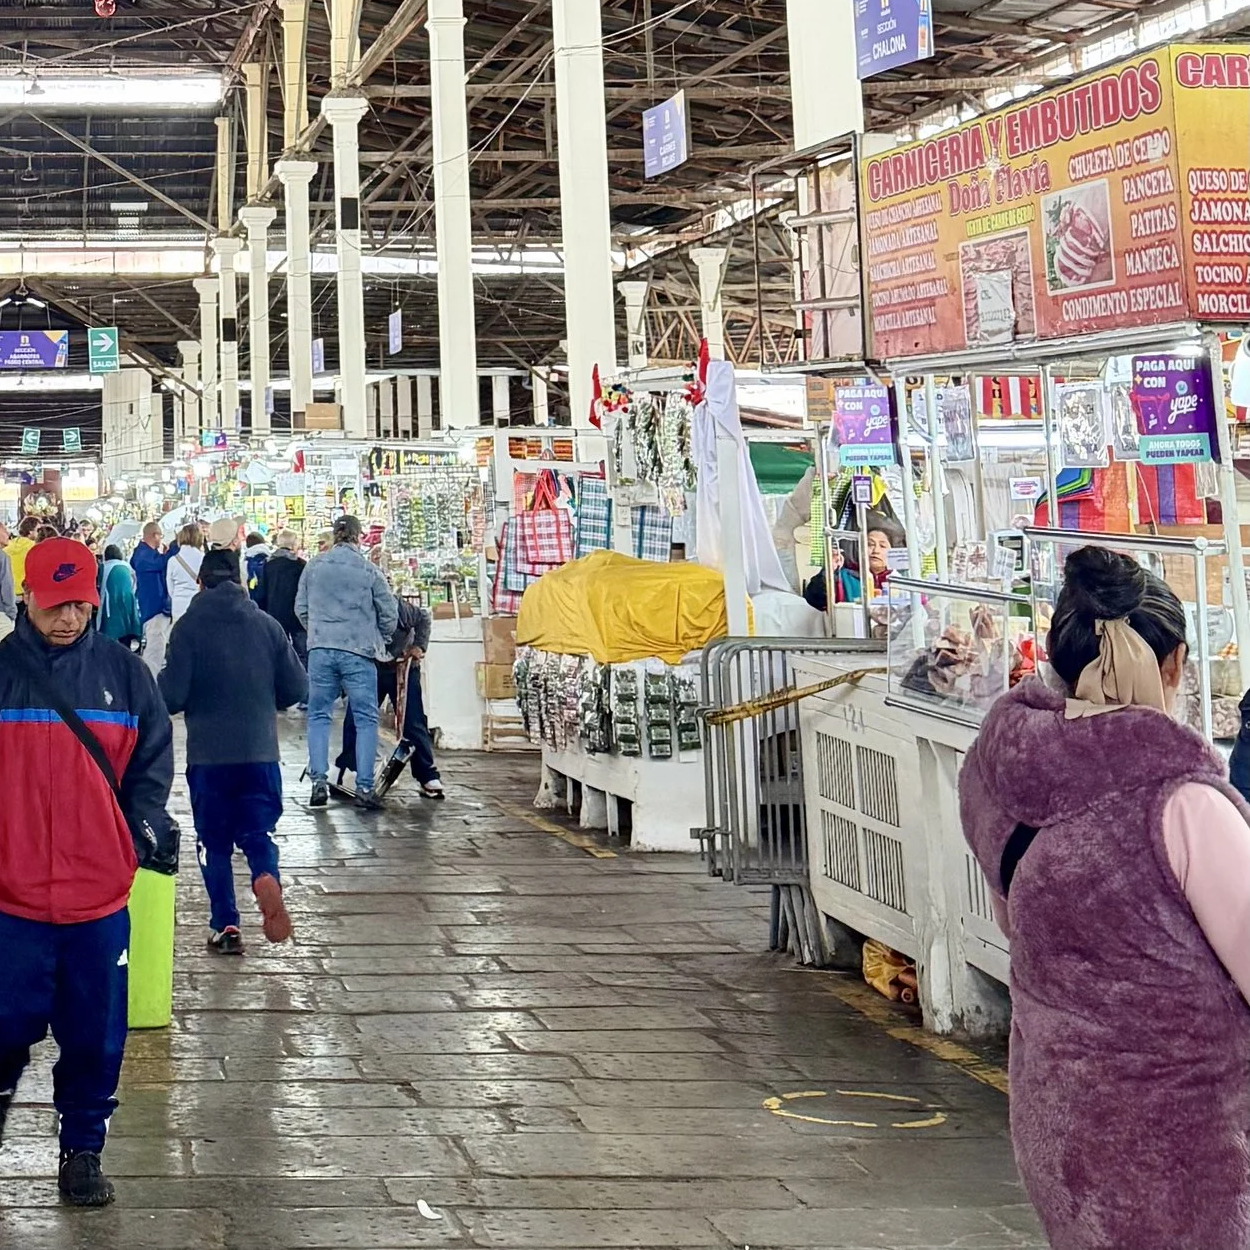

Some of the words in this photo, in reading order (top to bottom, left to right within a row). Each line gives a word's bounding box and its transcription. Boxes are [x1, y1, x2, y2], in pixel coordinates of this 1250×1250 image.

[872, 34, 907, 60] CHALONA
[869, 124, 986, 201] CARNICERIA
[1006, 59, 1161, 157] EMBUTIDOS
[1069, 146, 1115, 180] CHULETA
[1116, 142, 1130, 169] DE
[1123, 168, 1174, 202] PANCETA
[1189, 171, 1228, 193] QUESO
[1230, 171, 1247, 191] DE
[1131, 205, 1176, 238] PATITAS
[1125, 244, 1179, 276] MANTECA
[1196, 266, 1243, 283] TOCINO
[1062, 293, 1128, 321] CONDIMENTO
[1130, 282, 1182, 312] ESPECIAL
[93, 360, 117, 368] SALIDA
[1136, 360, 1166, 371] PAGA
[839, 389, 863, 398] PAGA
[1143, 377, 1166, 388] CON
[844, 401, 863, 410] CON
[1168, 394, 1198, 424] yape
[864, 415, 888, 437] yape
[1177, 449, 1204, 457] YAPEAR
